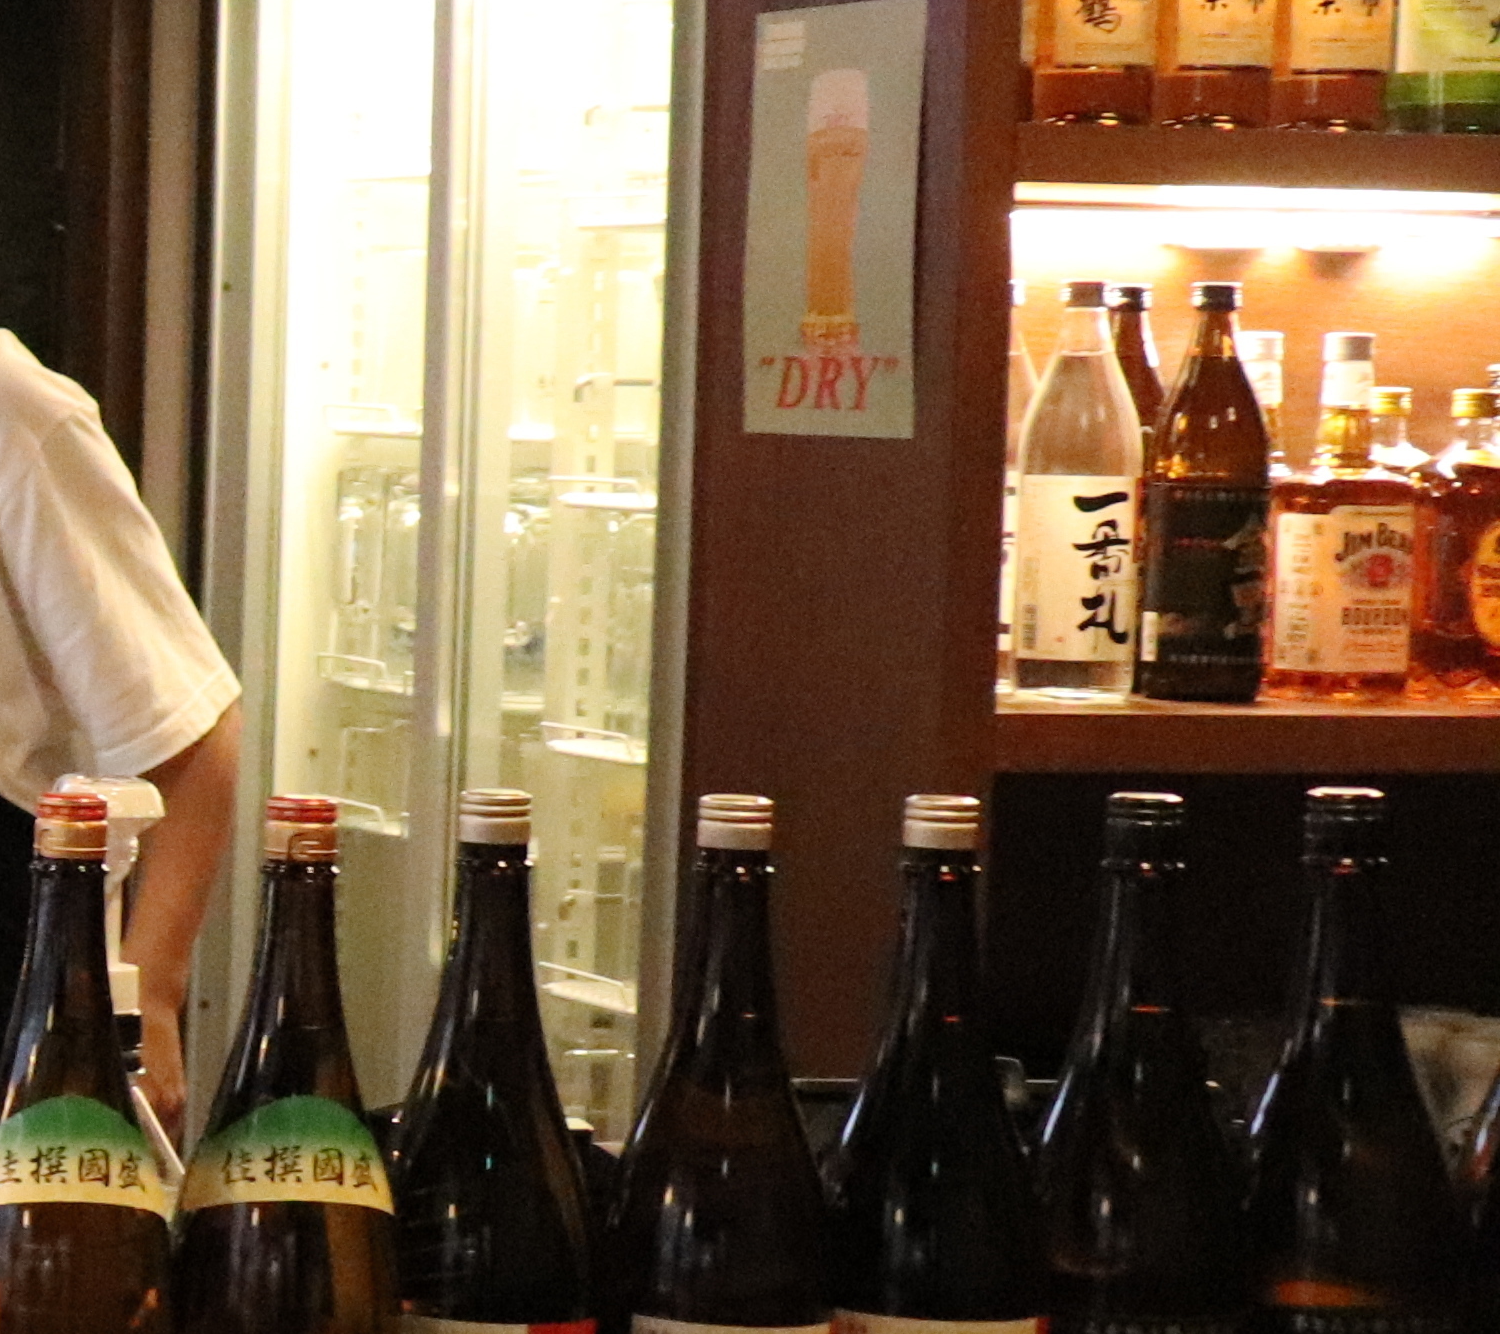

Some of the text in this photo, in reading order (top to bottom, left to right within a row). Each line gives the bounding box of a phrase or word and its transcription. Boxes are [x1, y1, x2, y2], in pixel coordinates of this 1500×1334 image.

[1376, 522, 1414, 554] BEA
[220, 1144, 380, 1193] 佳撰國盛
